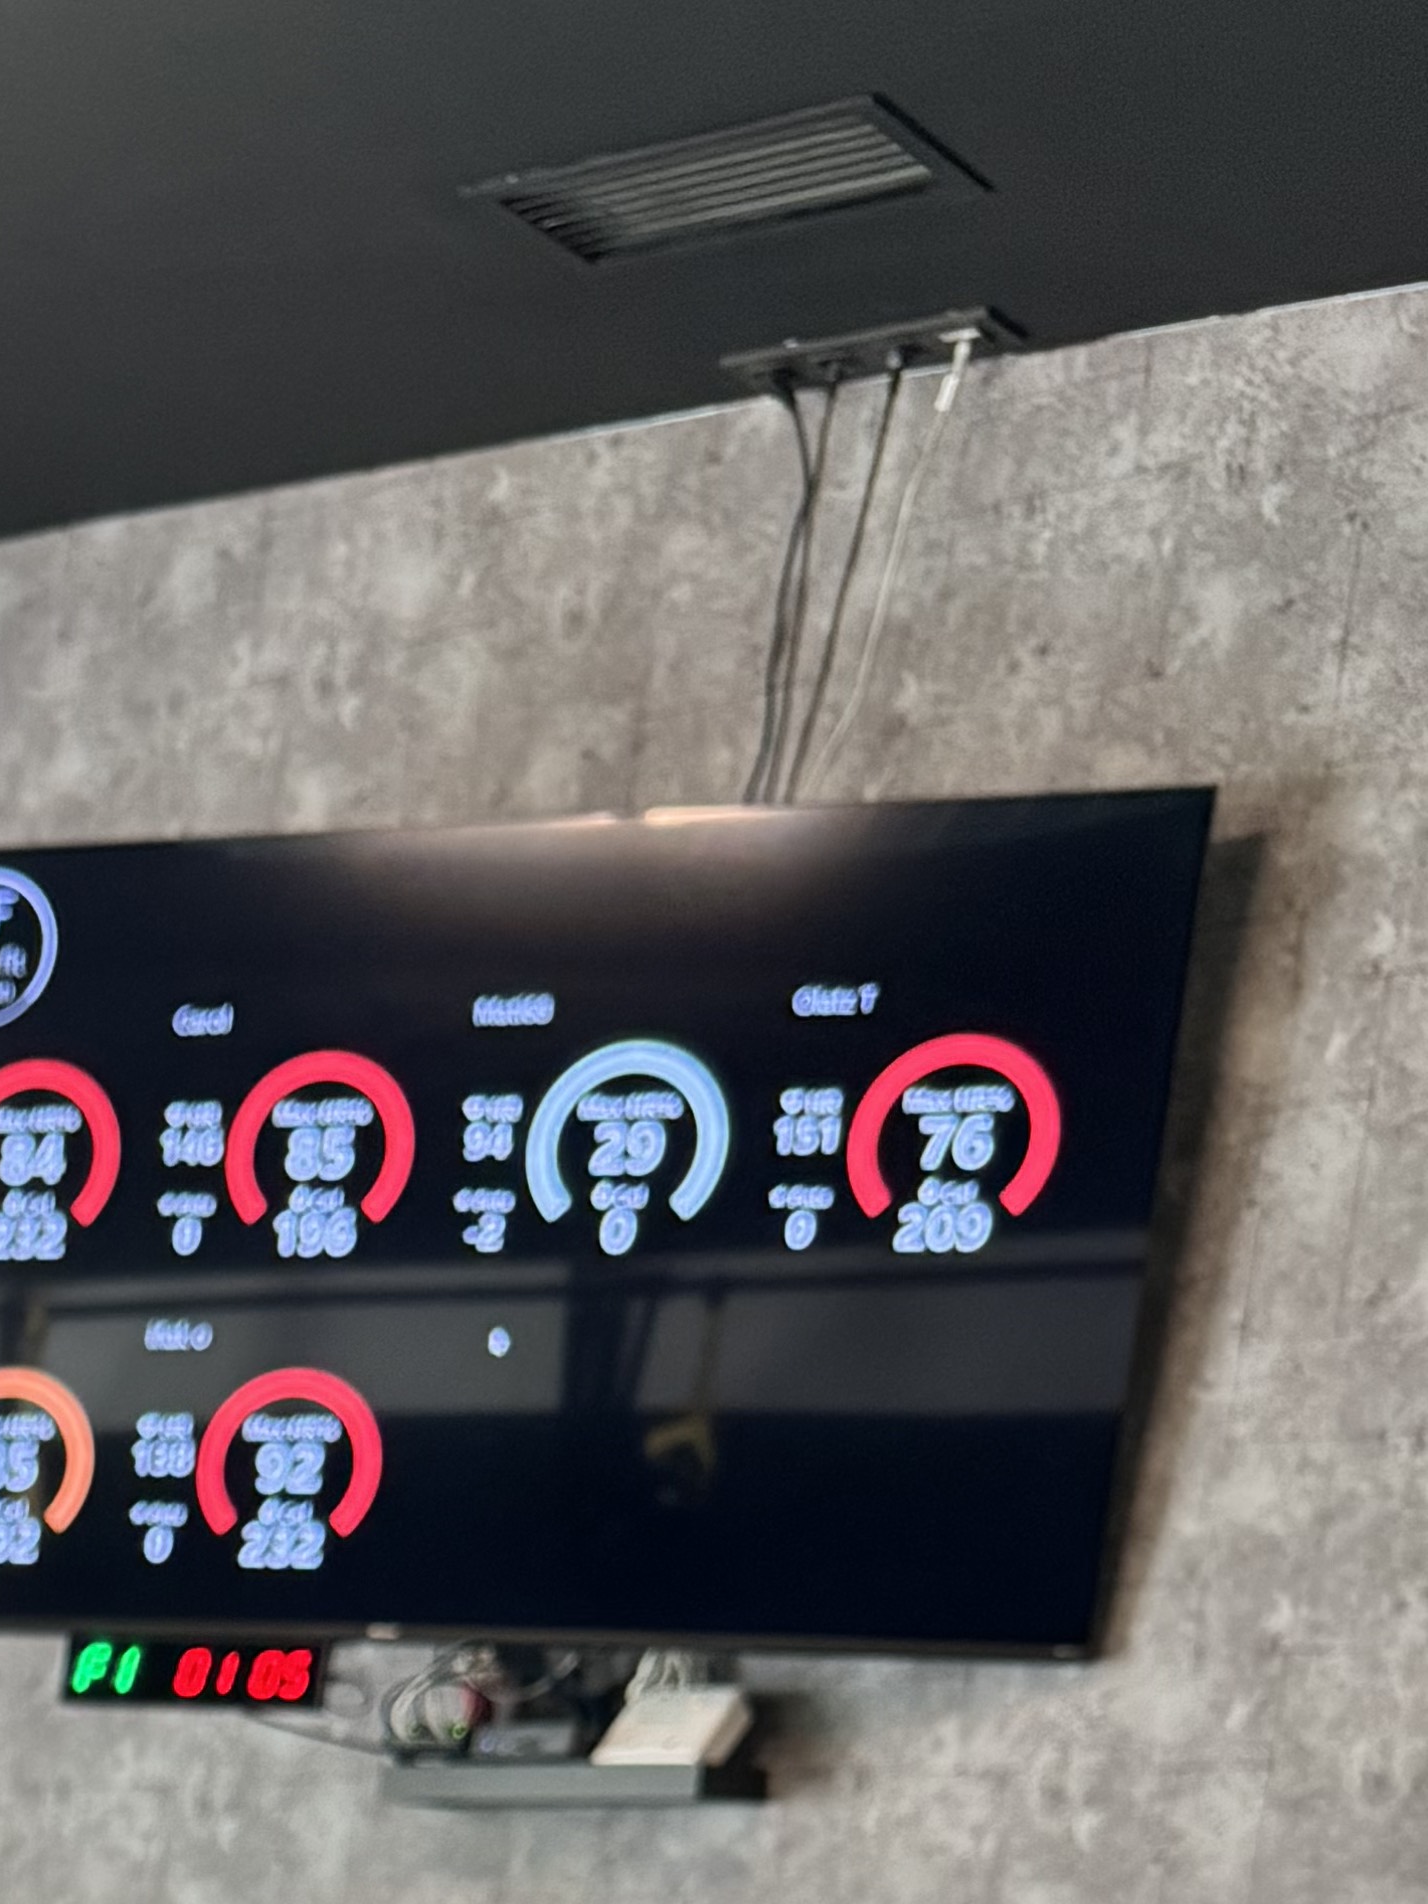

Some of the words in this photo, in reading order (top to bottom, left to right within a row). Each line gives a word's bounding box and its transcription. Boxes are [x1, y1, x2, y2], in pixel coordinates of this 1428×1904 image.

[285, 1127, 355, 1181] 85
[588, 1120, 666, 1177] 29
[773, 1115, 841, 1156] 151
[919, 1113, 994, 1171] 76
[599, 1208, 637, 1256] 0
[255, 1442, 325, 1495] 92
